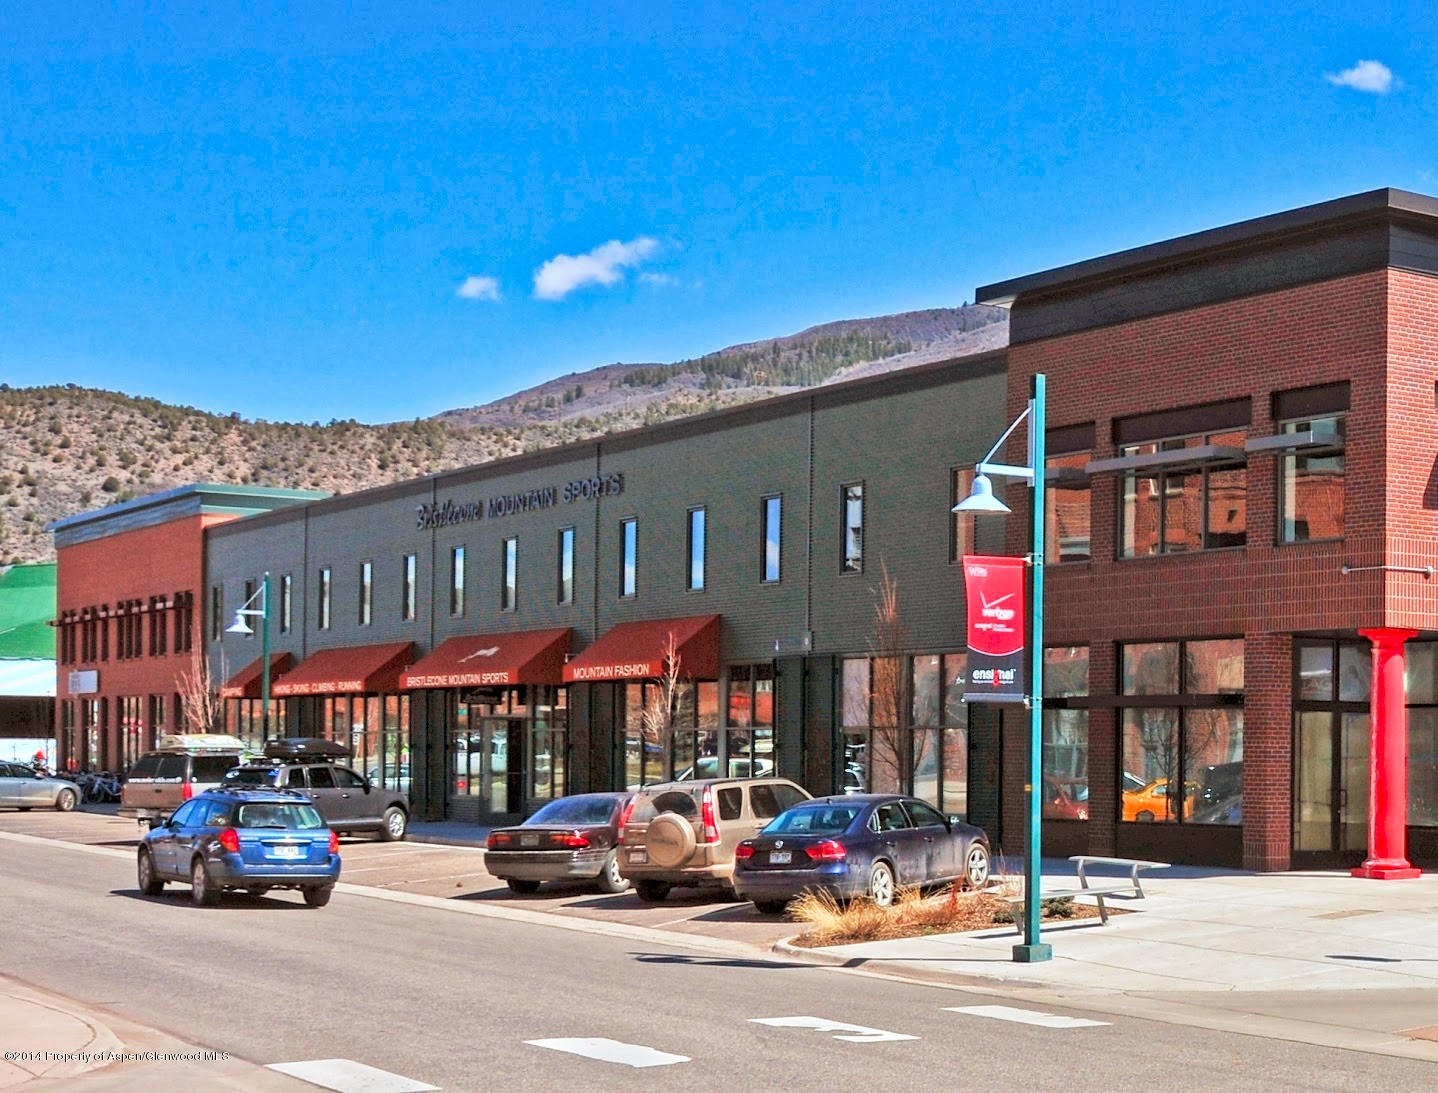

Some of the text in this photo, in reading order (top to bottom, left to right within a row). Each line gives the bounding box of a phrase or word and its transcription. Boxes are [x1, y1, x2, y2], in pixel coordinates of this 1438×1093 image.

[488, 487, 556, 518] MOUNTAIN
[563, 473, 624, 503] SPORTS
[573, 664, 649, 679] MOUNTAIN FASHION
[406, 672, 508, 688] BRISTLECONE MOUNTAIN SPORTS
